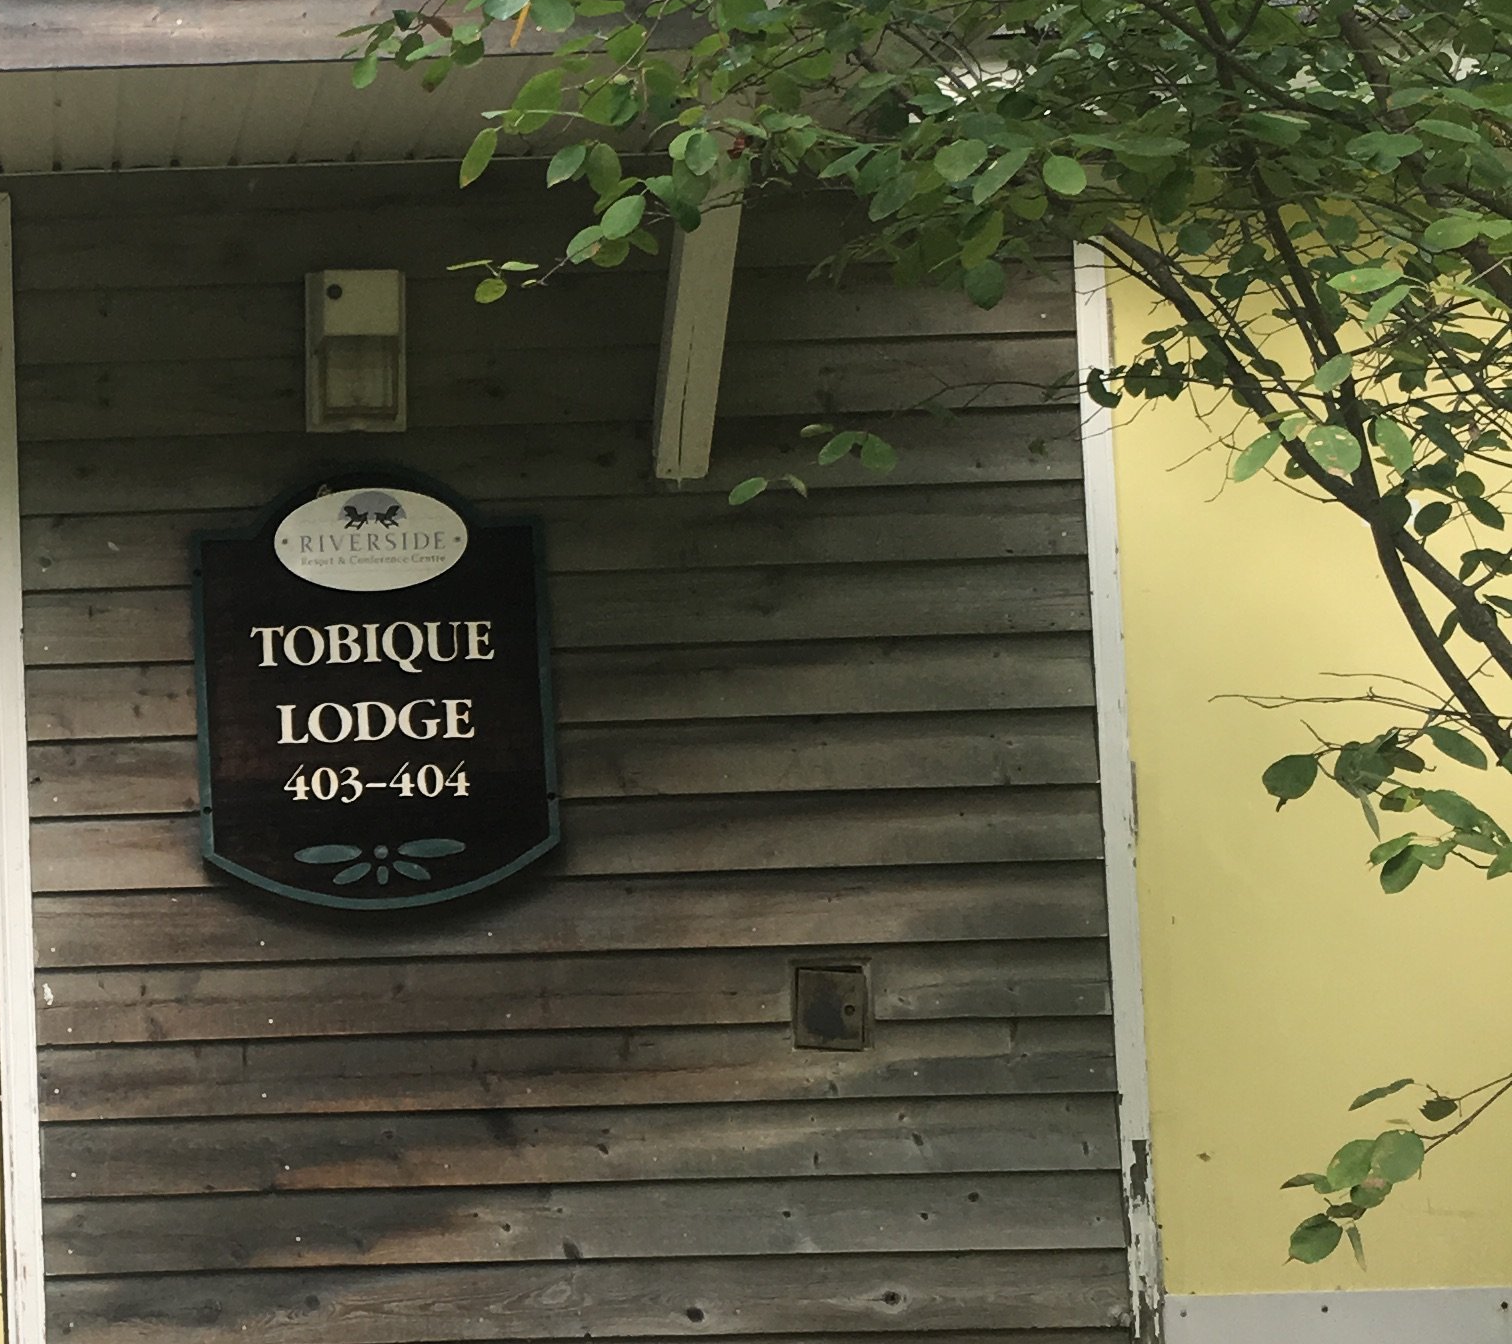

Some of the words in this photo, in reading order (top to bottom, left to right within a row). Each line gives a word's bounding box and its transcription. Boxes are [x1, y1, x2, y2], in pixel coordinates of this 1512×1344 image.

[299, 530, 447, 554] RIVERSIDE
[249, 620, 495, 673] TOBIQUE
[275, 697, 476, 746] LODGE
[283, 760, 471, 804] 403-404
